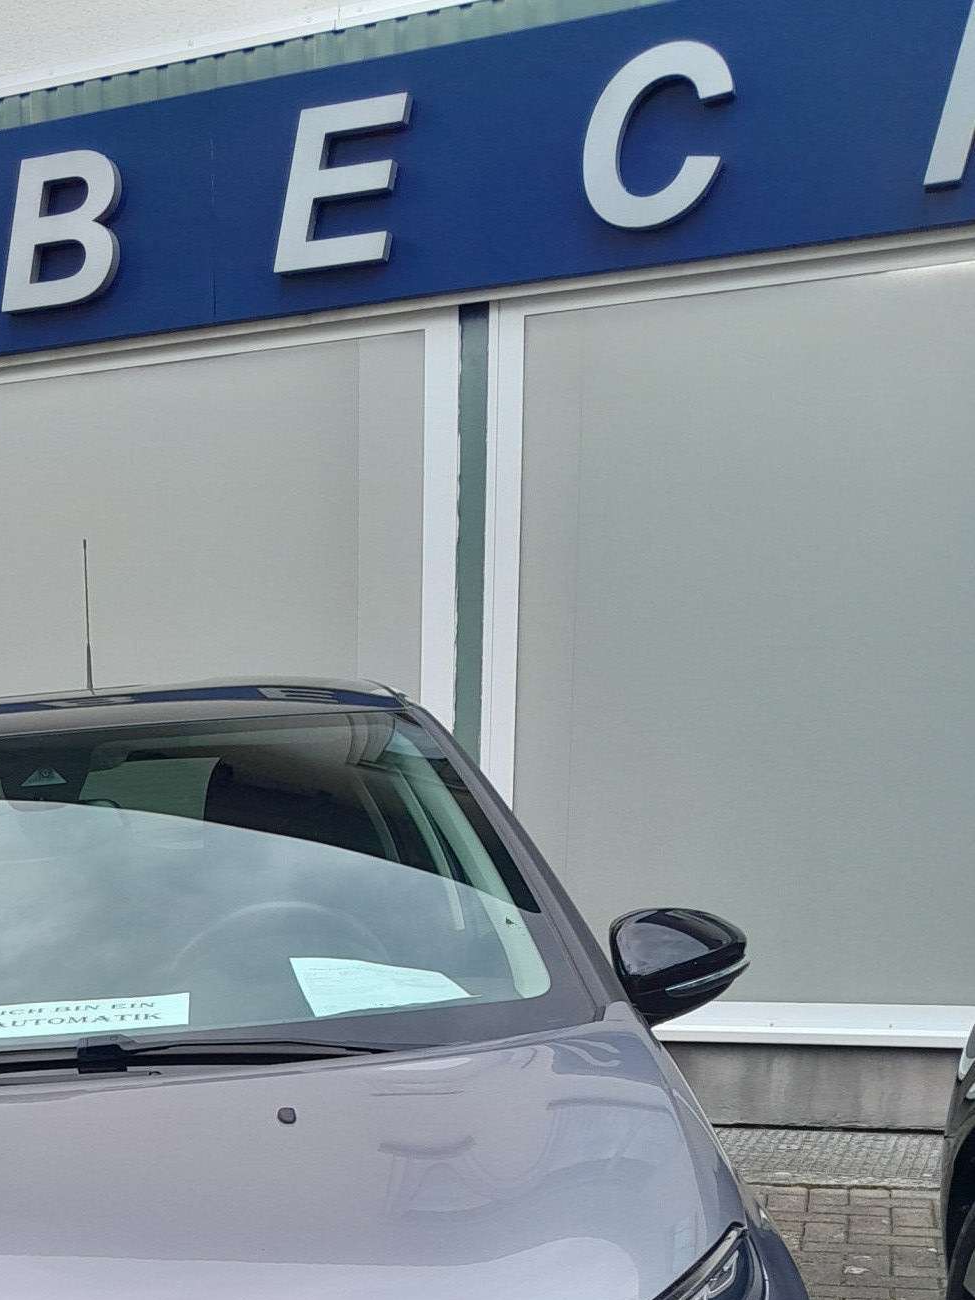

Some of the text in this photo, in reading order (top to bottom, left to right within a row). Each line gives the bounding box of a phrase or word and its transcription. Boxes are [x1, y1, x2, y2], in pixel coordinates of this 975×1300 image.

[0, 1001, 155, 1016] ICH BIN EIN
